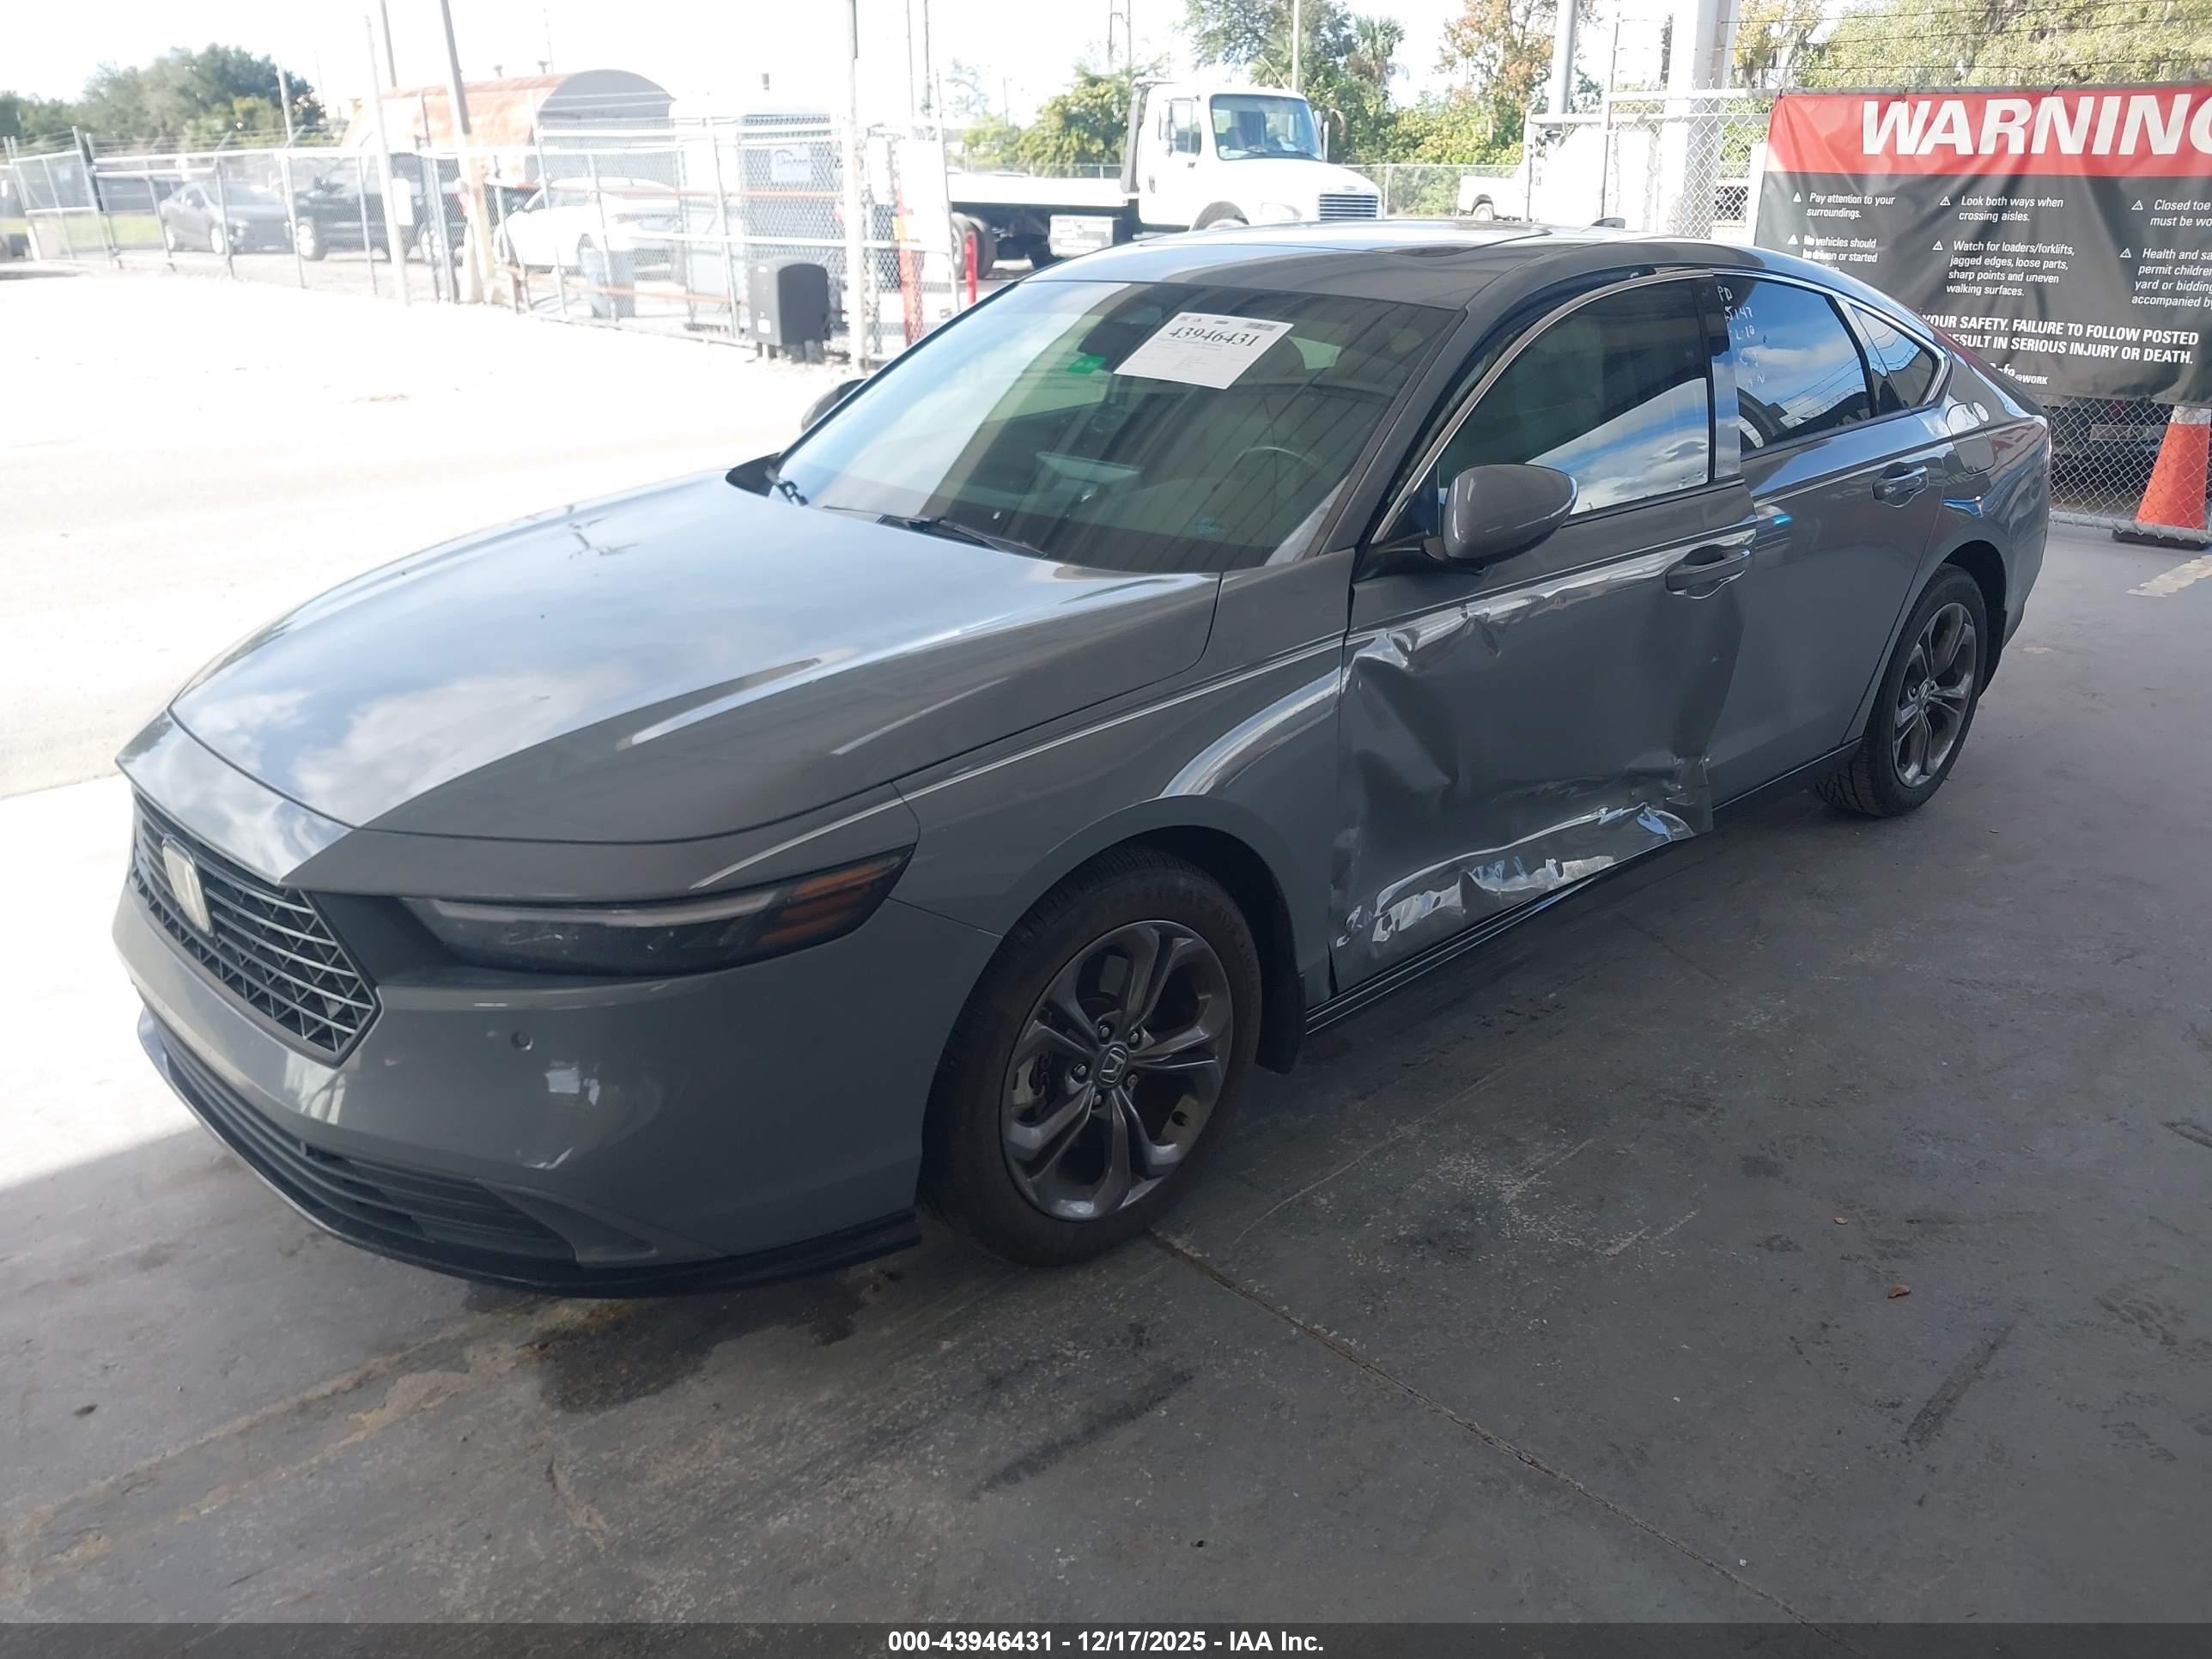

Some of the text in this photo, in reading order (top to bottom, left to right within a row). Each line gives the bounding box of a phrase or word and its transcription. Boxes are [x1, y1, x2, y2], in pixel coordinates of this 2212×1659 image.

[1809, 192, 1896, 206] Pay attention to your
[1961, 196, 2063, 209] Look both ways when
[2154, 199, 2211, 210] Closed toe
[1806, 207, 1862, 220] surroundings.
[1959, 210, 2030, 222] crossing aisles.
[2149, 216, 2178, 227] must
[2179, 216, 2193, 227] be
[1804, 234, 1877, 248] No vehicles should
[1953, 240, 2075, 256] Watch for loaders/forklifts,
[2142, 247, 2176, 259] Health
[2178, 248, 2199, 260] and
[1802, 248, 1878, 263] be driven or started
[1949, 254, 2069, 270] jagged edges, loose parts,
[2137, 264, 2172, 276] permit
[1948, 270, 2060, 284] sharp points and uneven
[1946, 284, 2025, 296] walking surfaces.
[2135, 279, 2160, 291] yard
[2161, 282, 2174, 290] or
[2131, 295, 2202, 307] accompanied
[1169, 326, 1261, 347] 43946431
[1959, 316, 2008, 331] SAFETY.
[2012, 319, 2065, 336] FAILURE
[2067, 323, 2083, 337] TO
[2086, 325, 2142, 342] FOLLOW
[2142, 329, 2199, 345] POSTED
[1948, 333, 2193, 365] ESULT IN SERIOUS INJURY OR DEATH.
